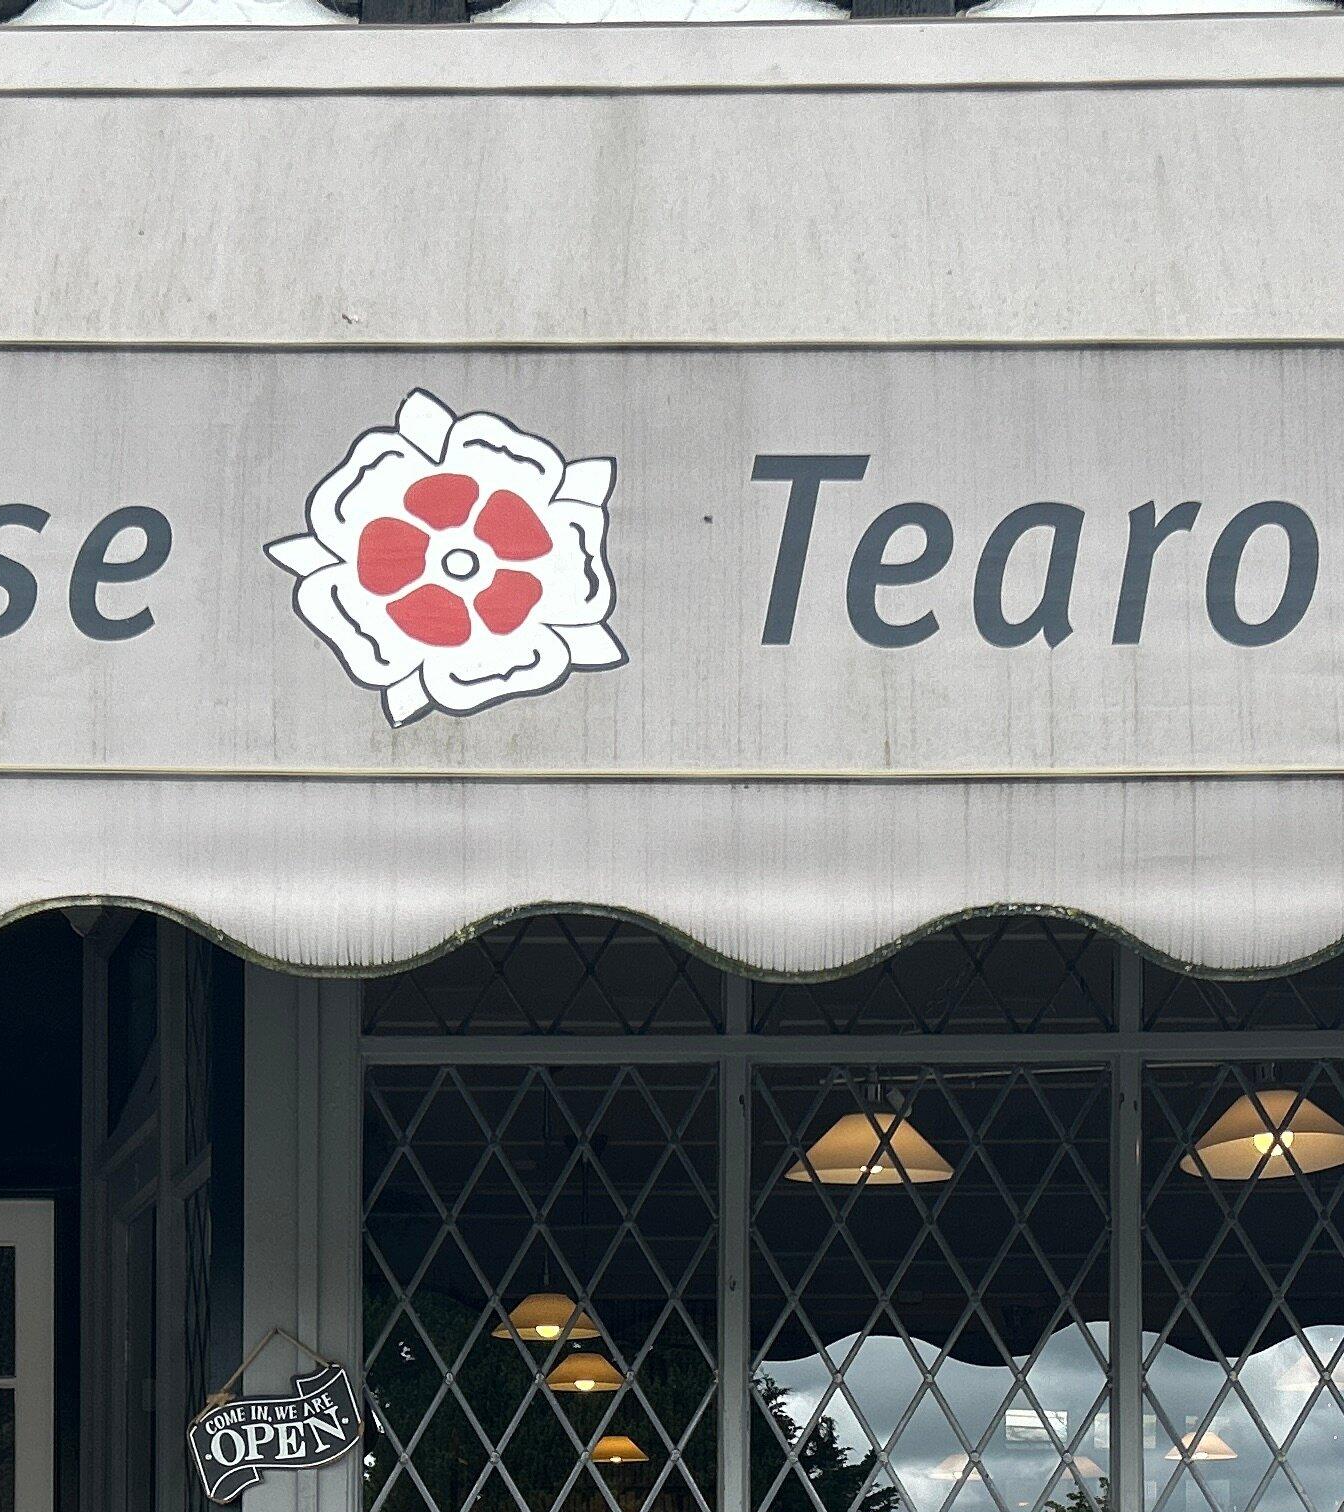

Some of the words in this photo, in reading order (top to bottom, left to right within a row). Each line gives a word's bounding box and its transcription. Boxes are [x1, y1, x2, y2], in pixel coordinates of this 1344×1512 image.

[205, 1406, 246, 1435] COME
[251, 1405, 272, 1422] IN,
[275, 1404, 298, 1421] WE
[303, 1392, 334, 1416] ARE
[210, 1405, 347, 1467] OPEN
